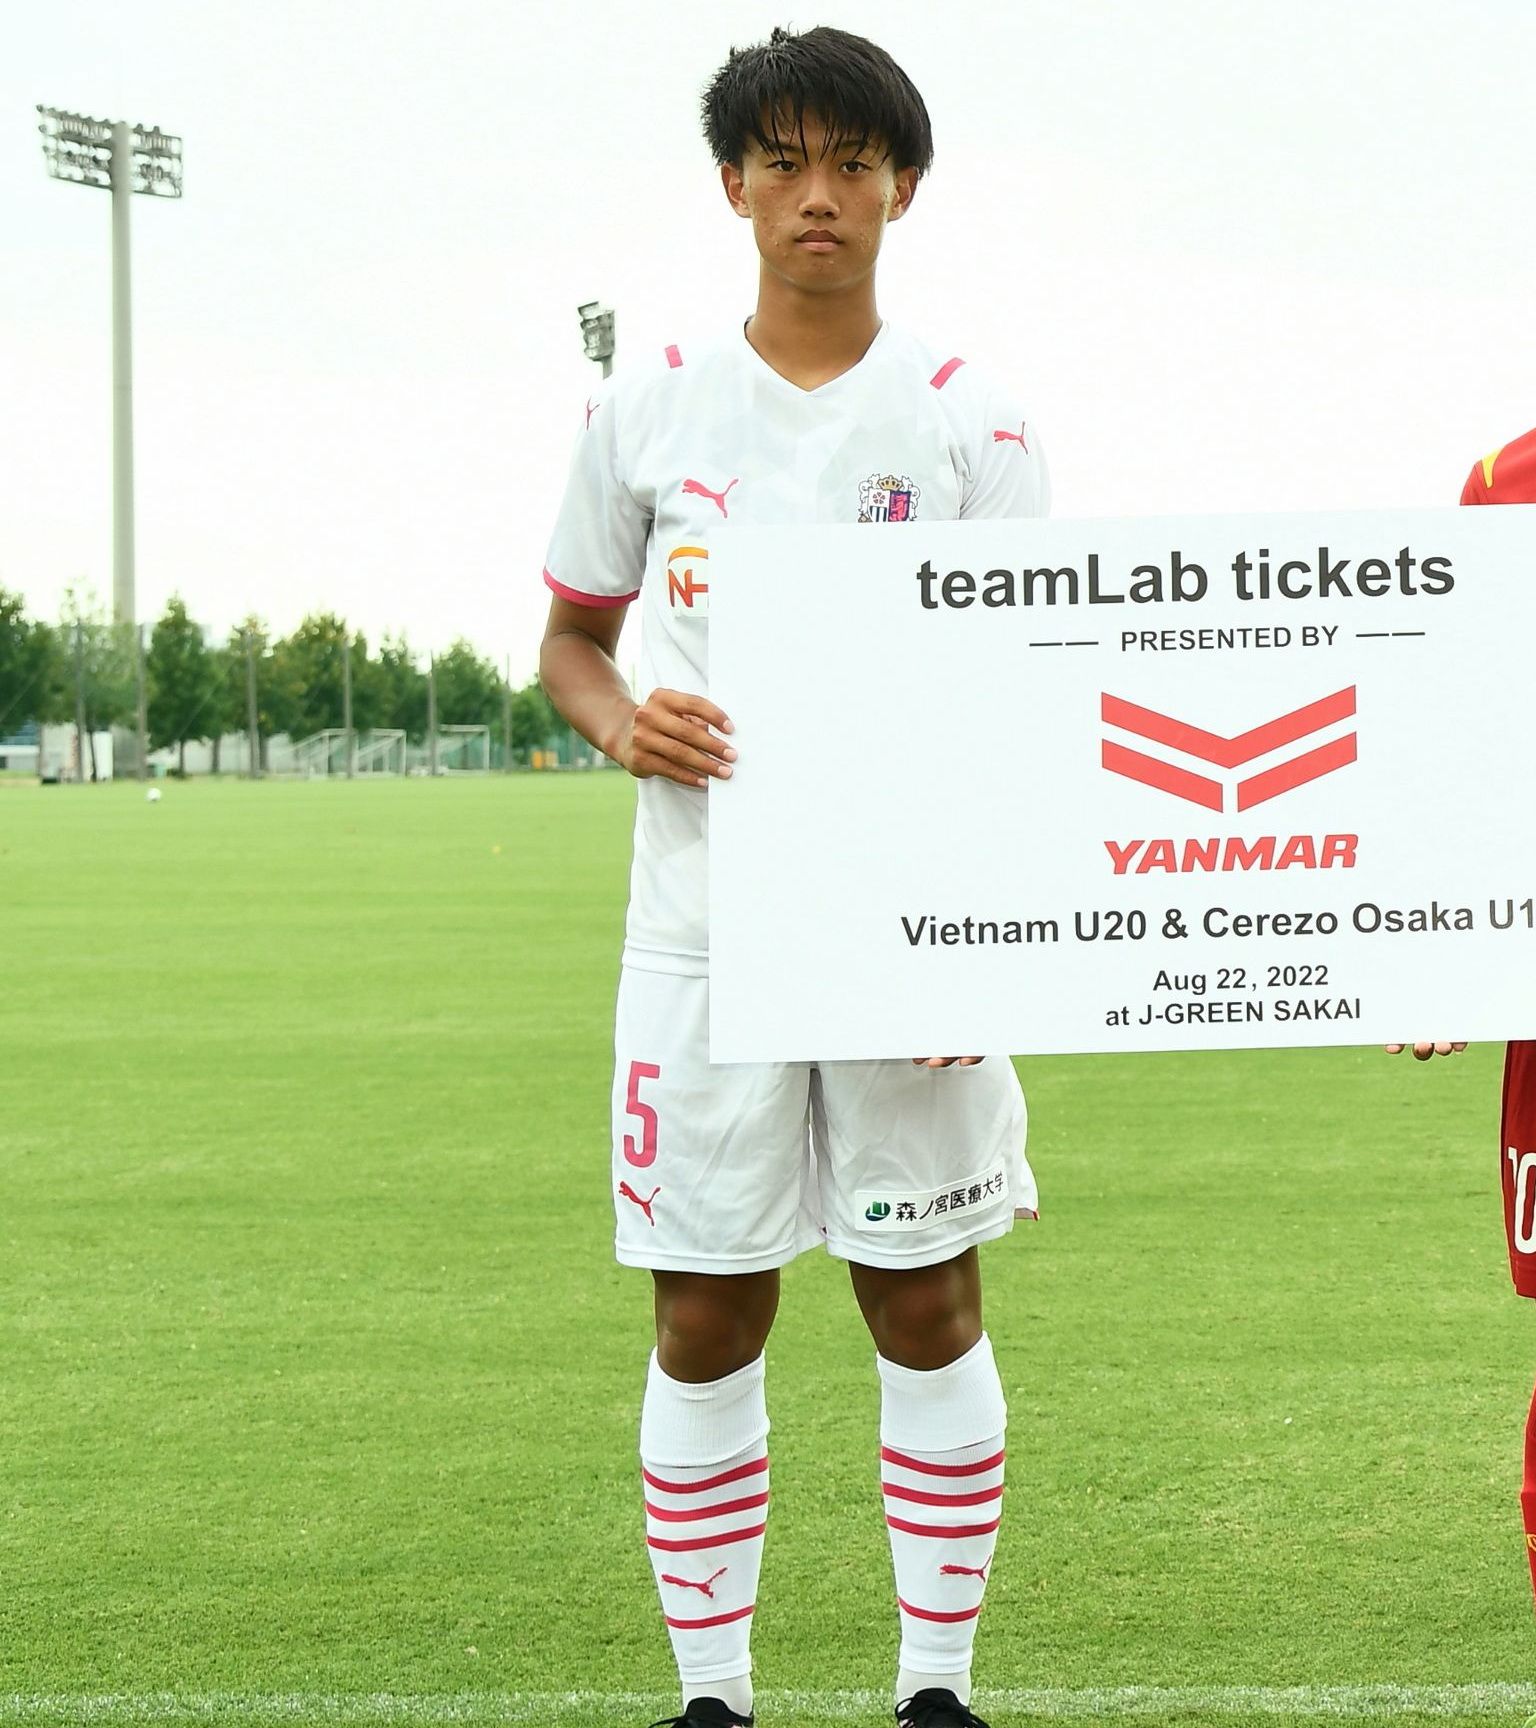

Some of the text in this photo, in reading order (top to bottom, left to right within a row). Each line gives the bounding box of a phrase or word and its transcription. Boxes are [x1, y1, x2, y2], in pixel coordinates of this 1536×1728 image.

[916, 546, 1455, 609] teamLab tickets
[1120, 625, 1339, 652] PRESENTED BY
[1103, 834, 1359, 875] YANMAR
[900, 915, 1059, 946] Vietnam
[1074, 909, 1147, 942] U20
[1161, 908, 1189, 940] &
[1203, 907, 1338, 938] Cerezo
[1352, 901, 1474, 934] Osaka
[1152, 964, 1329, 996] Aug 22, 2022
[1105, 998, 1360, 1027] at J-GREEN SAKAI
[623, 1061, 660, 1168] 5
[897, 1172, 1004, 1221] 森ノ宮医療大学
